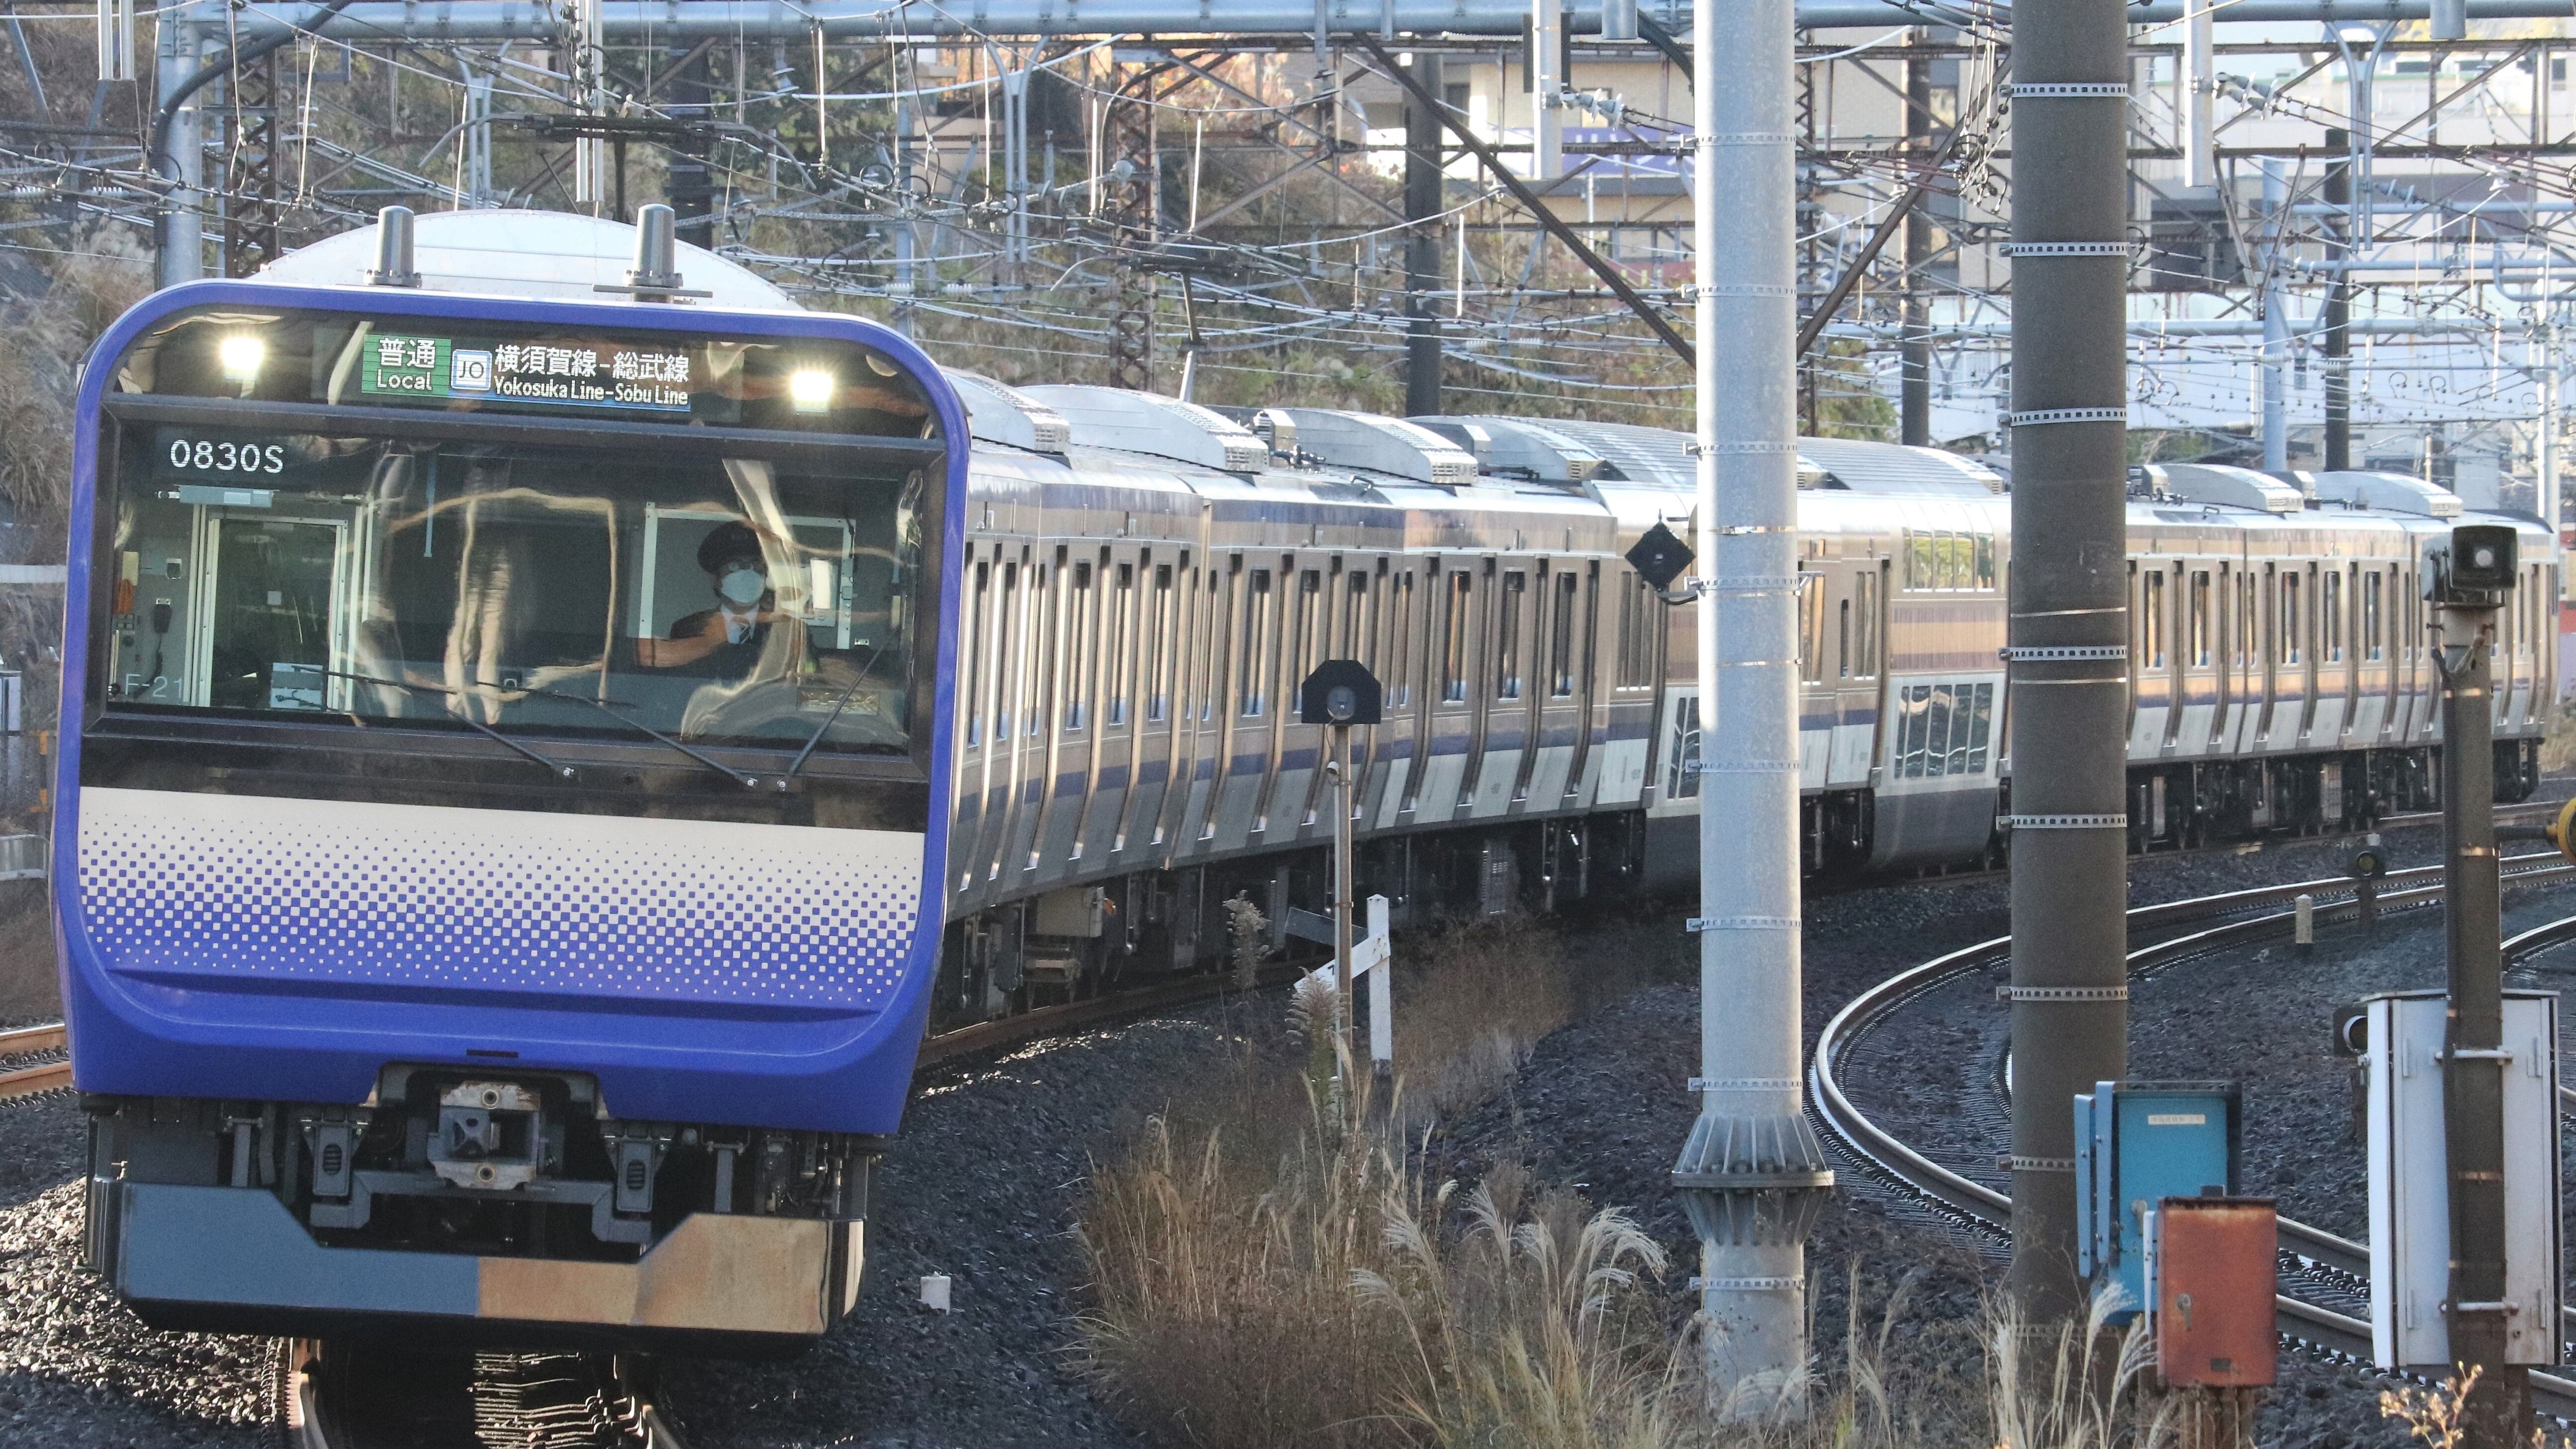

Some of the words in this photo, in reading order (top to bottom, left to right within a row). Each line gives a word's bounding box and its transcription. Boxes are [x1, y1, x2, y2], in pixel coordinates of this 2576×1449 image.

[378, 337, 436, 368] 普通
[377, 369, 432, 390] Local
[459, 361, 484, 379] JO
[494, 376, 568, 398] Yokosuka
[655, 385, 688, 405] Line
[171, 439, 284, 473] 0830S
[125, 673, 184, 699] F-21
